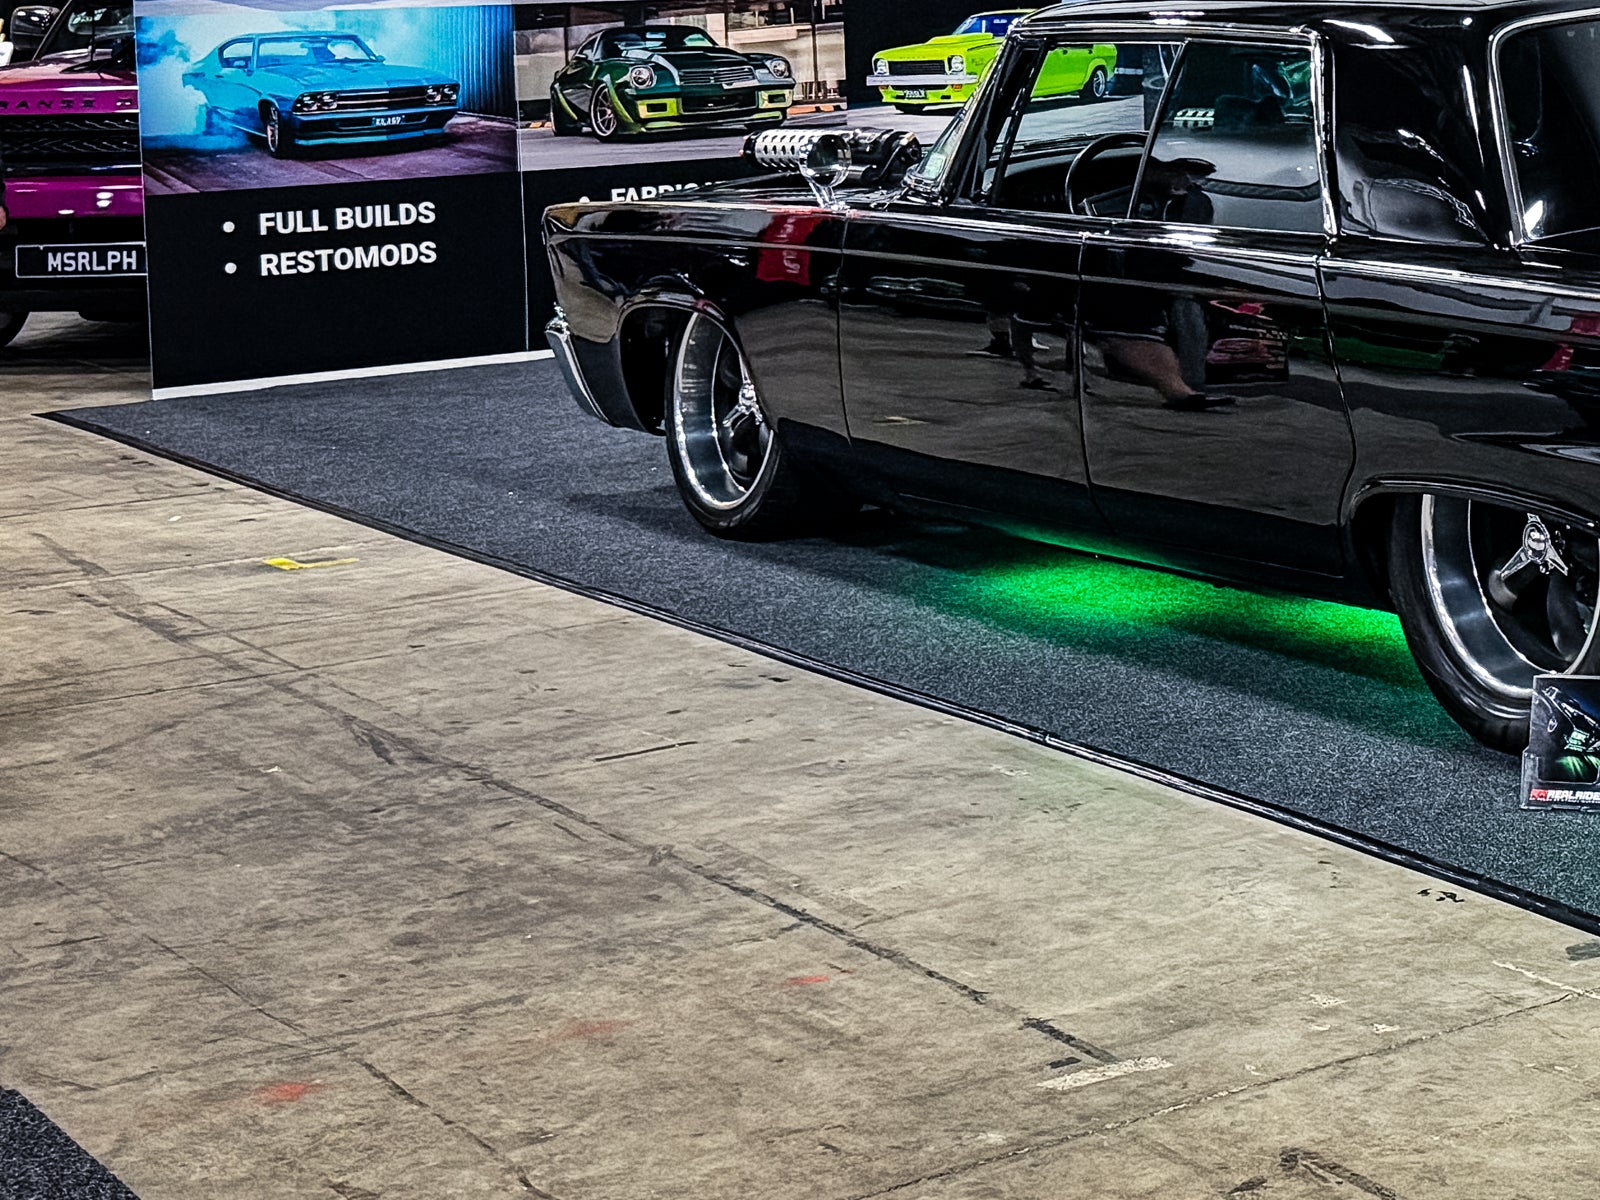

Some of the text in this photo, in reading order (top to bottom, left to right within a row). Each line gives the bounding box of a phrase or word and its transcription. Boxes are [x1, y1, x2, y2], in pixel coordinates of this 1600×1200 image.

[258, 201, 437, 237] FULL BUILDS
[47, 250, 137, 272] MSRLPH
[259, 241, 438, 277] RESTOMODS
